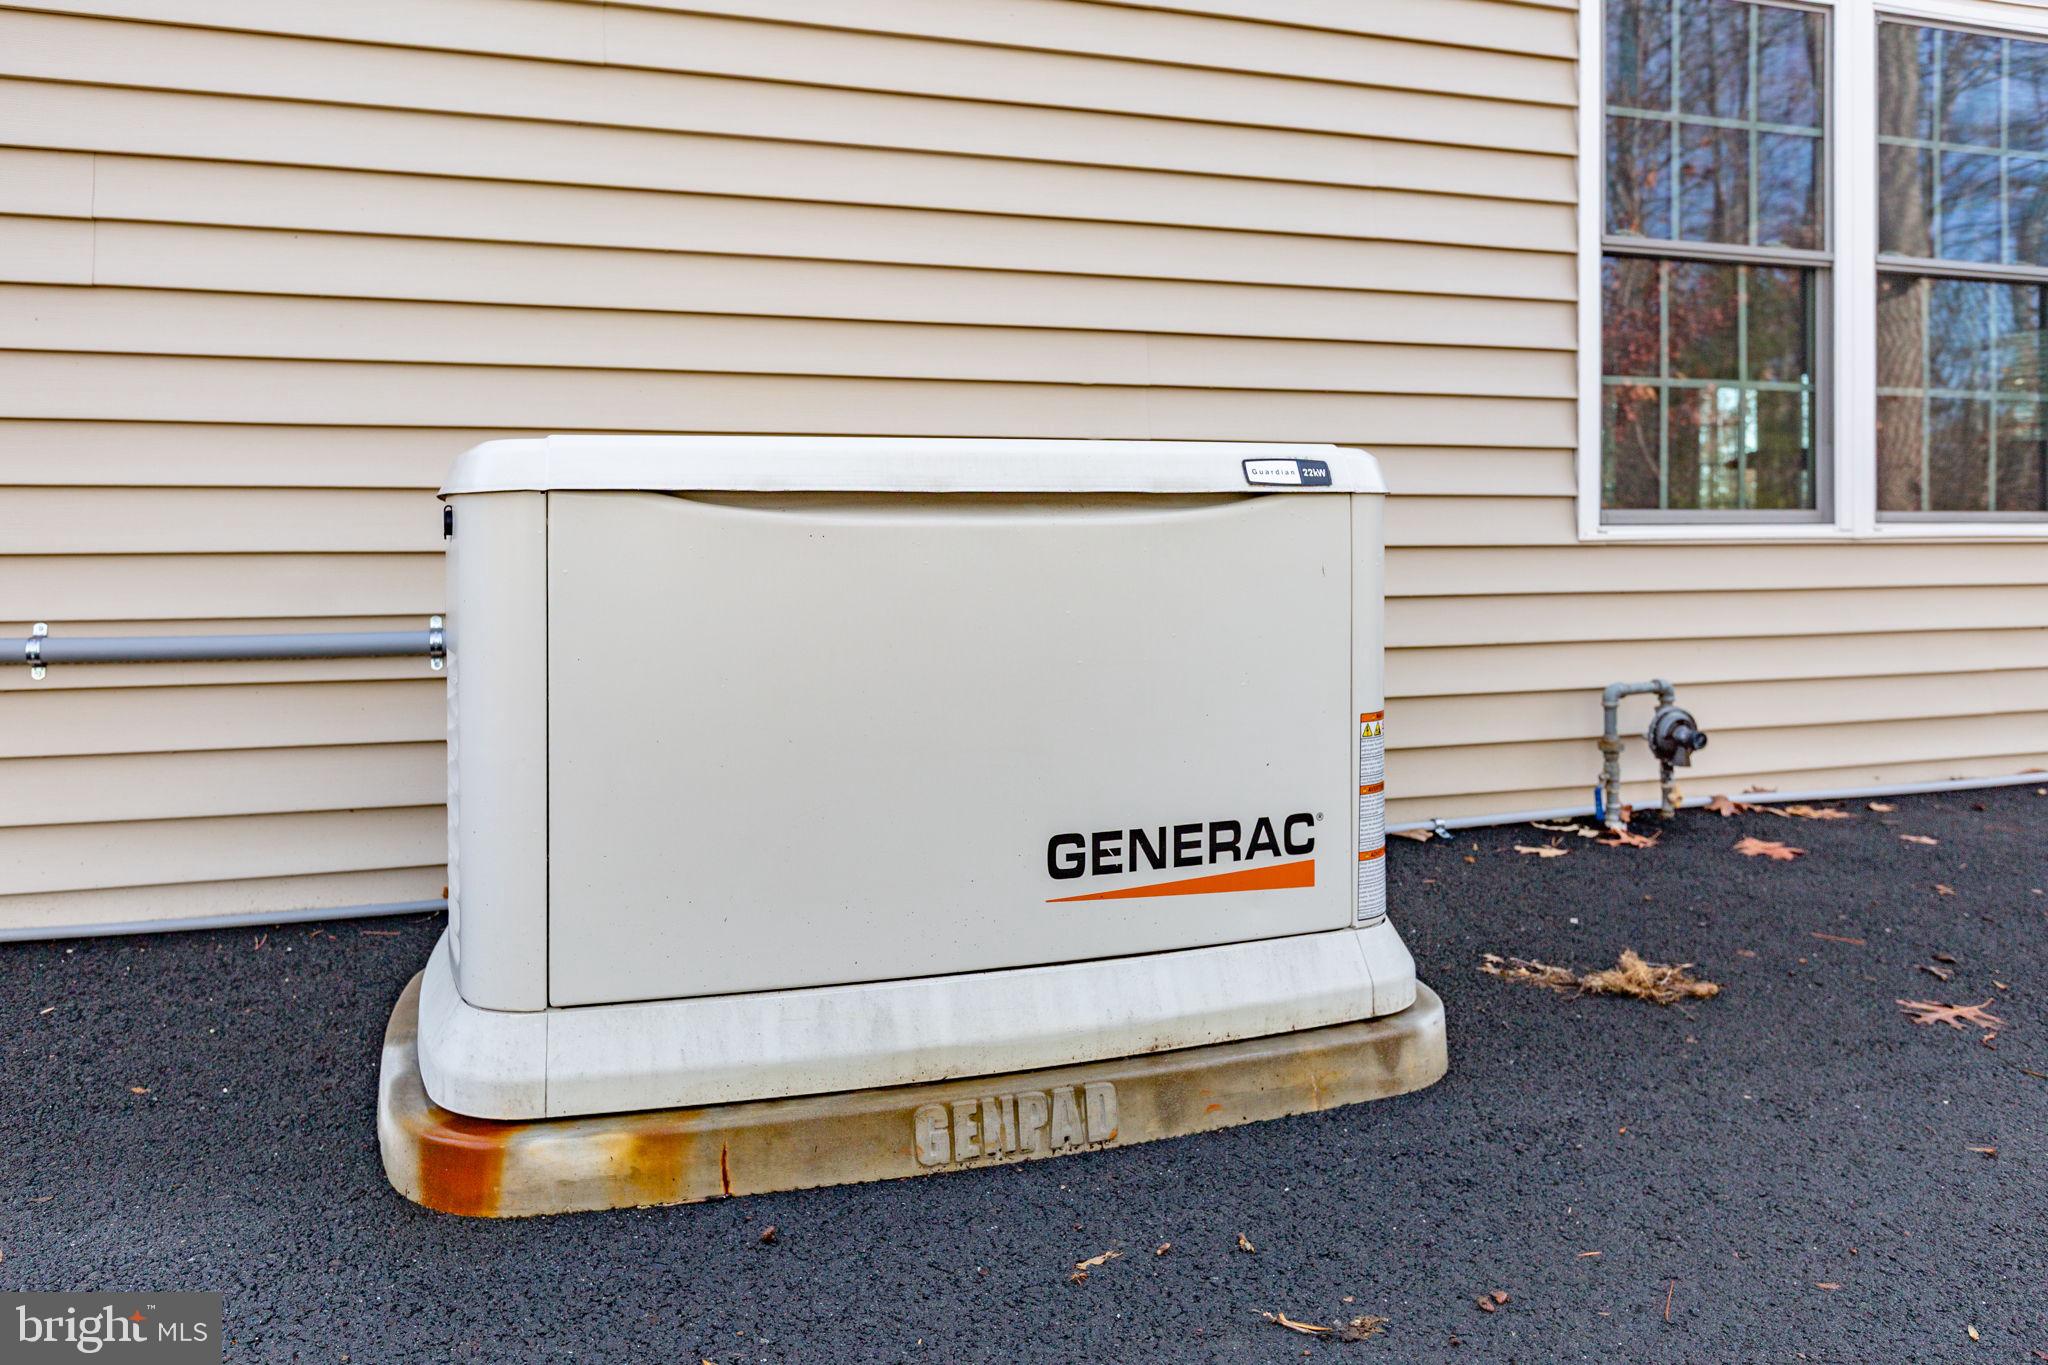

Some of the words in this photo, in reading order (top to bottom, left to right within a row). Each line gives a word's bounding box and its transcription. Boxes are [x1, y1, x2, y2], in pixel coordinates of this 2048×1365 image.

[1302, 468, 1326, 477] 22kW
[1047, 812, 1315, 880] GENERAC
[913, 1081, 1119, 1167] GENPAD
